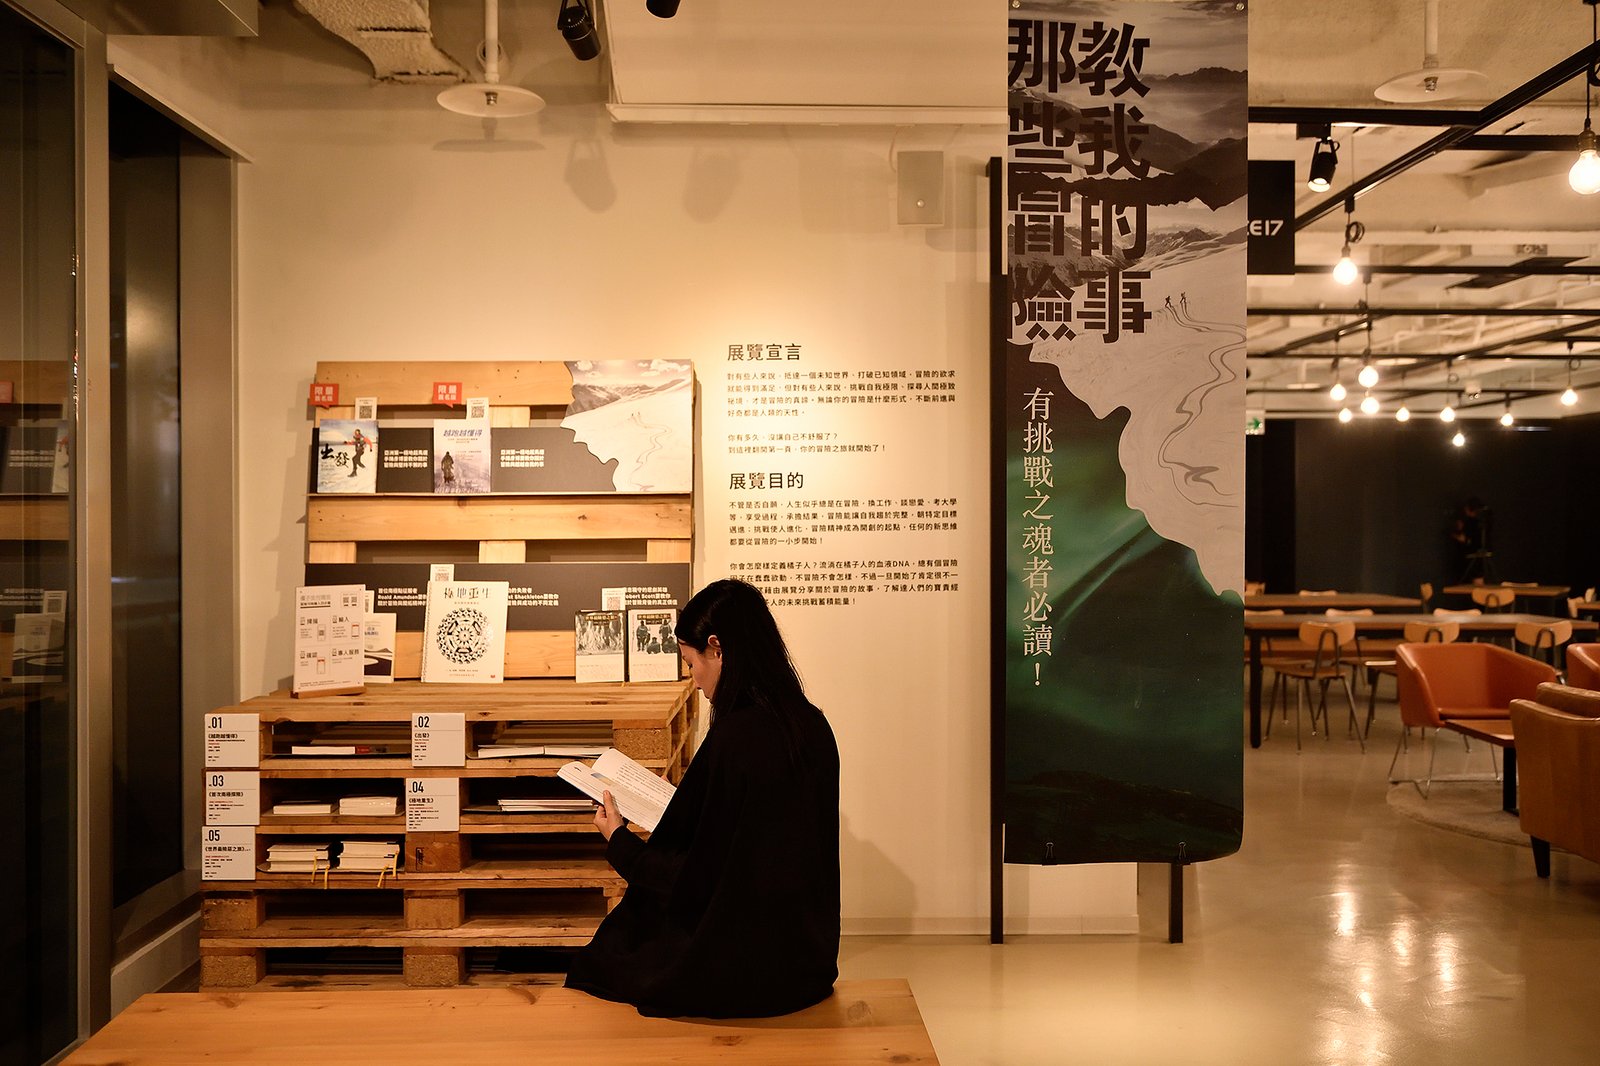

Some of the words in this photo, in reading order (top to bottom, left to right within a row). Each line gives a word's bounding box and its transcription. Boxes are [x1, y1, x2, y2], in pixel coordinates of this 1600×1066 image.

[1077, 21, 1152, 344] 教我的事
[1247, 219, 1284, 236] E17
[727, 343, 802, 361] 展覽宣言
[729, 472, 804, 490] 展覽目的
[1022, 387, 1055, 686] 有挑戰之魂者必讀！
